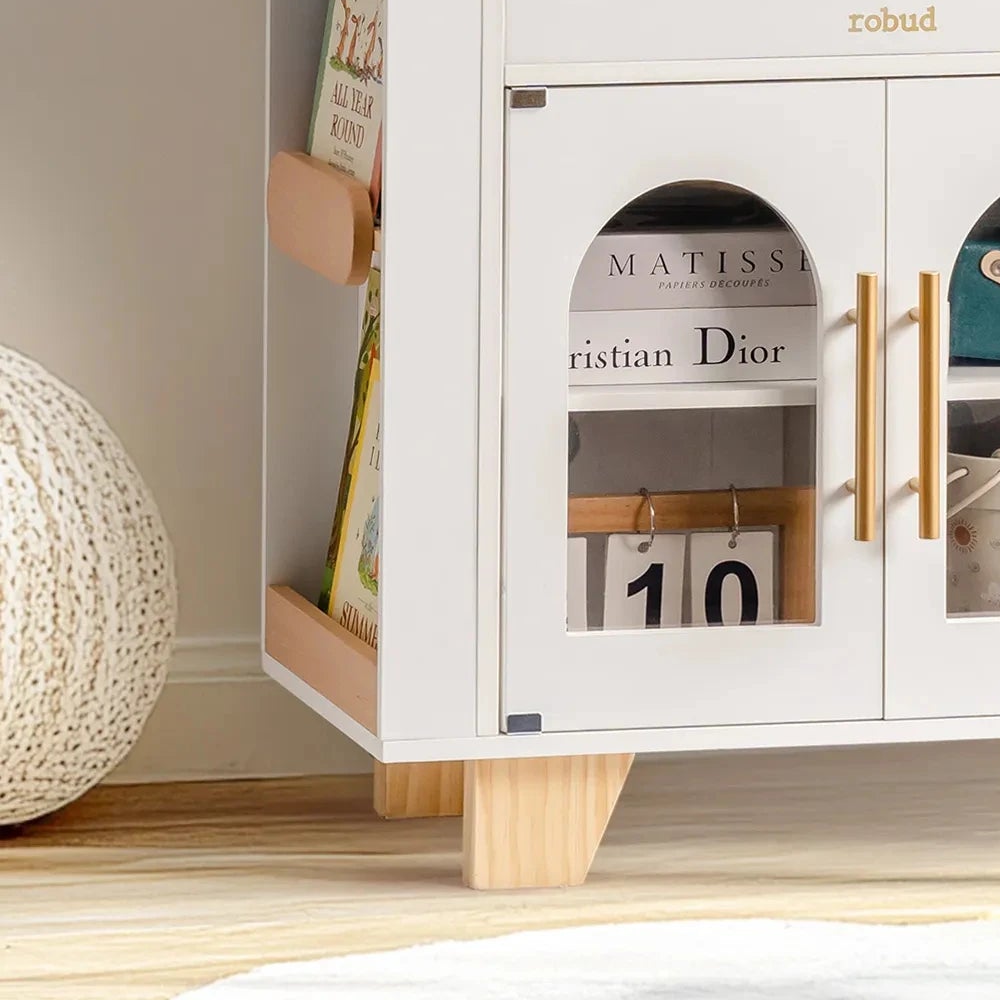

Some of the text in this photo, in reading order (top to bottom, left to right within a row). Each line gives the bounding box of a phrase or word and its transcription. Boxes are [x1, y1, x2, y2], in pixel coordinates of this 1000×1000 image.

[848, 5, 937, 33] robud
[330, 80, 375, 120] ALL YEAR
[330, 113, 365, 149] ROUND
[658, 280, 706, 290] PAPIERS
[568, 326, 787, 370] ristian Dior
